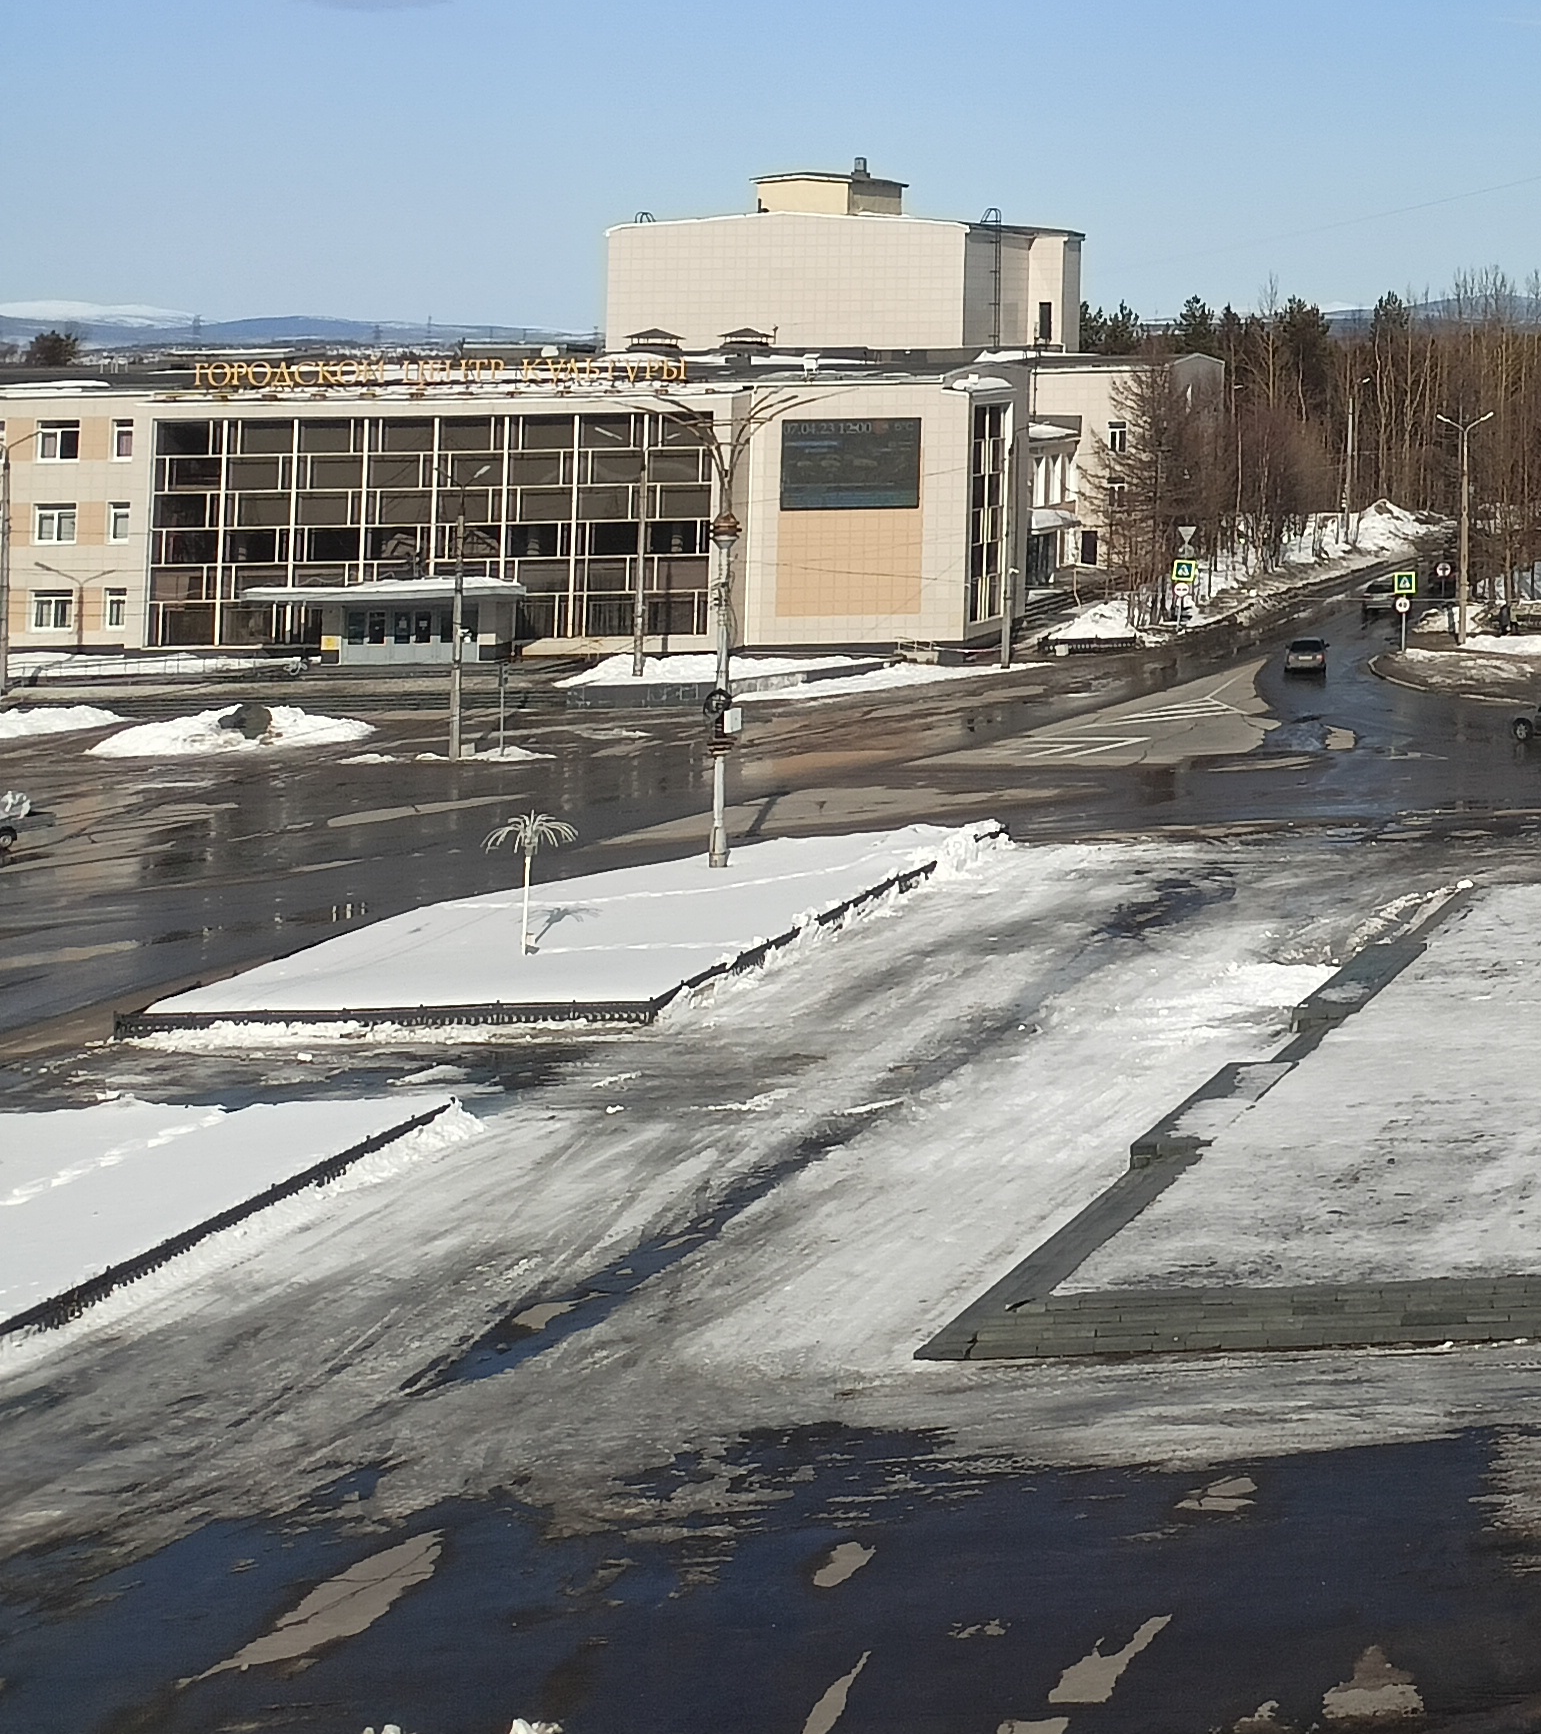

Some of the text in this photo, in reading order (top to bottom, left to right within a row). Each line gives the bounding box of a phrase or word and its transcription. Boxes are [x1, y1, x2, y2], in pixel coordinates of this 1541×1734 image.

[194, 351, 687, 389] ГОРОДСКОЙ ЦЕНТР КУЛЬТУРЫ
[783, 421, 872, 435] 07.04.23 12:00
